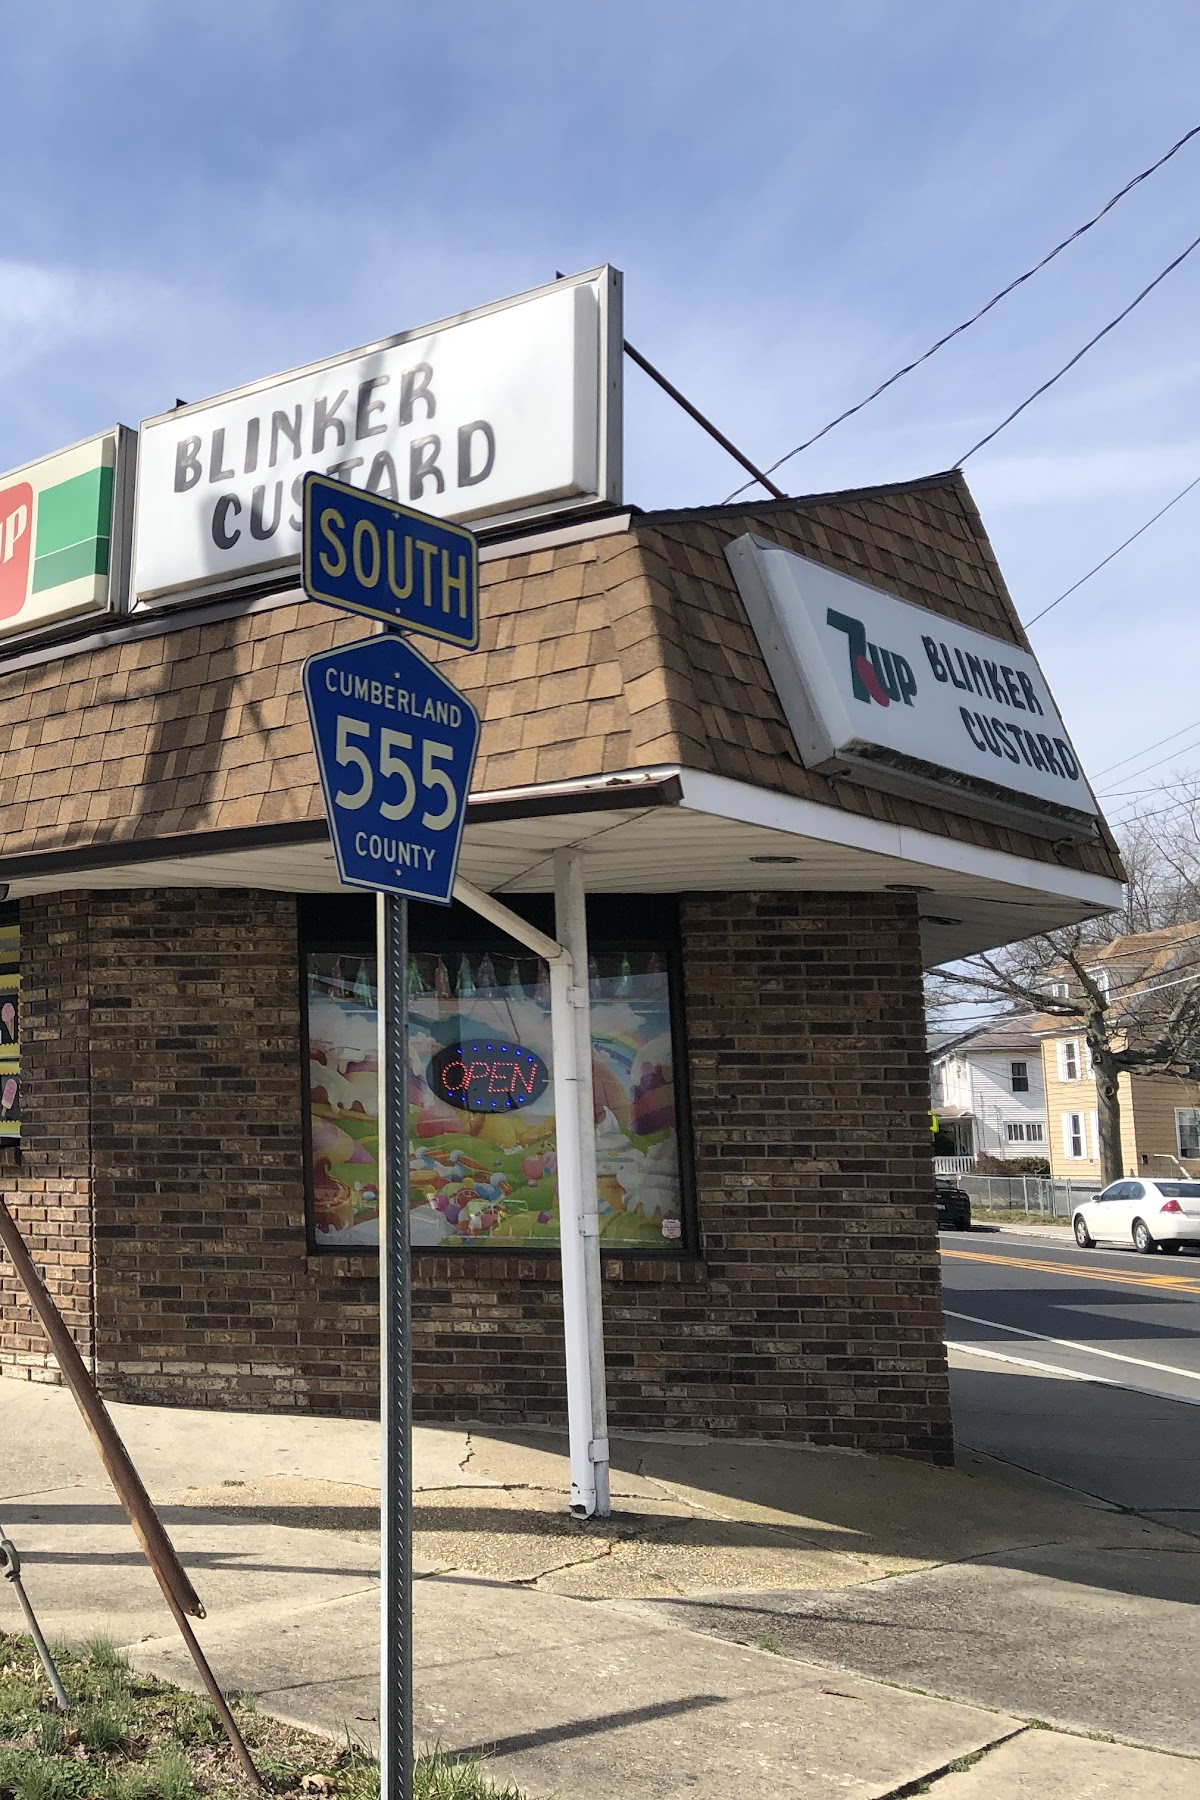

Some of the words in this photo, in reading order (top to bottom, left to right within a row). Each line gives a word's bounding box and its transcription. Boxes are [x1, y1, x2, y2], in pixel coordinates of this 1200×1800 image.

[174, 362, 437, 493] BLINKER
[318, 507, 468, 620] SOUTH
[325, 667, 463, 729] CUMBERLAND
[826, 607, 918, 709] 7UP
[921, 634, 1045, 717] BLINKER
[334, 714, 458, 832] 555
[959, 706, 1080, 782] CUSTARD
[354, 830, 437, 873] COUNTY
[441, 1060, 538, 1094] OPEN
